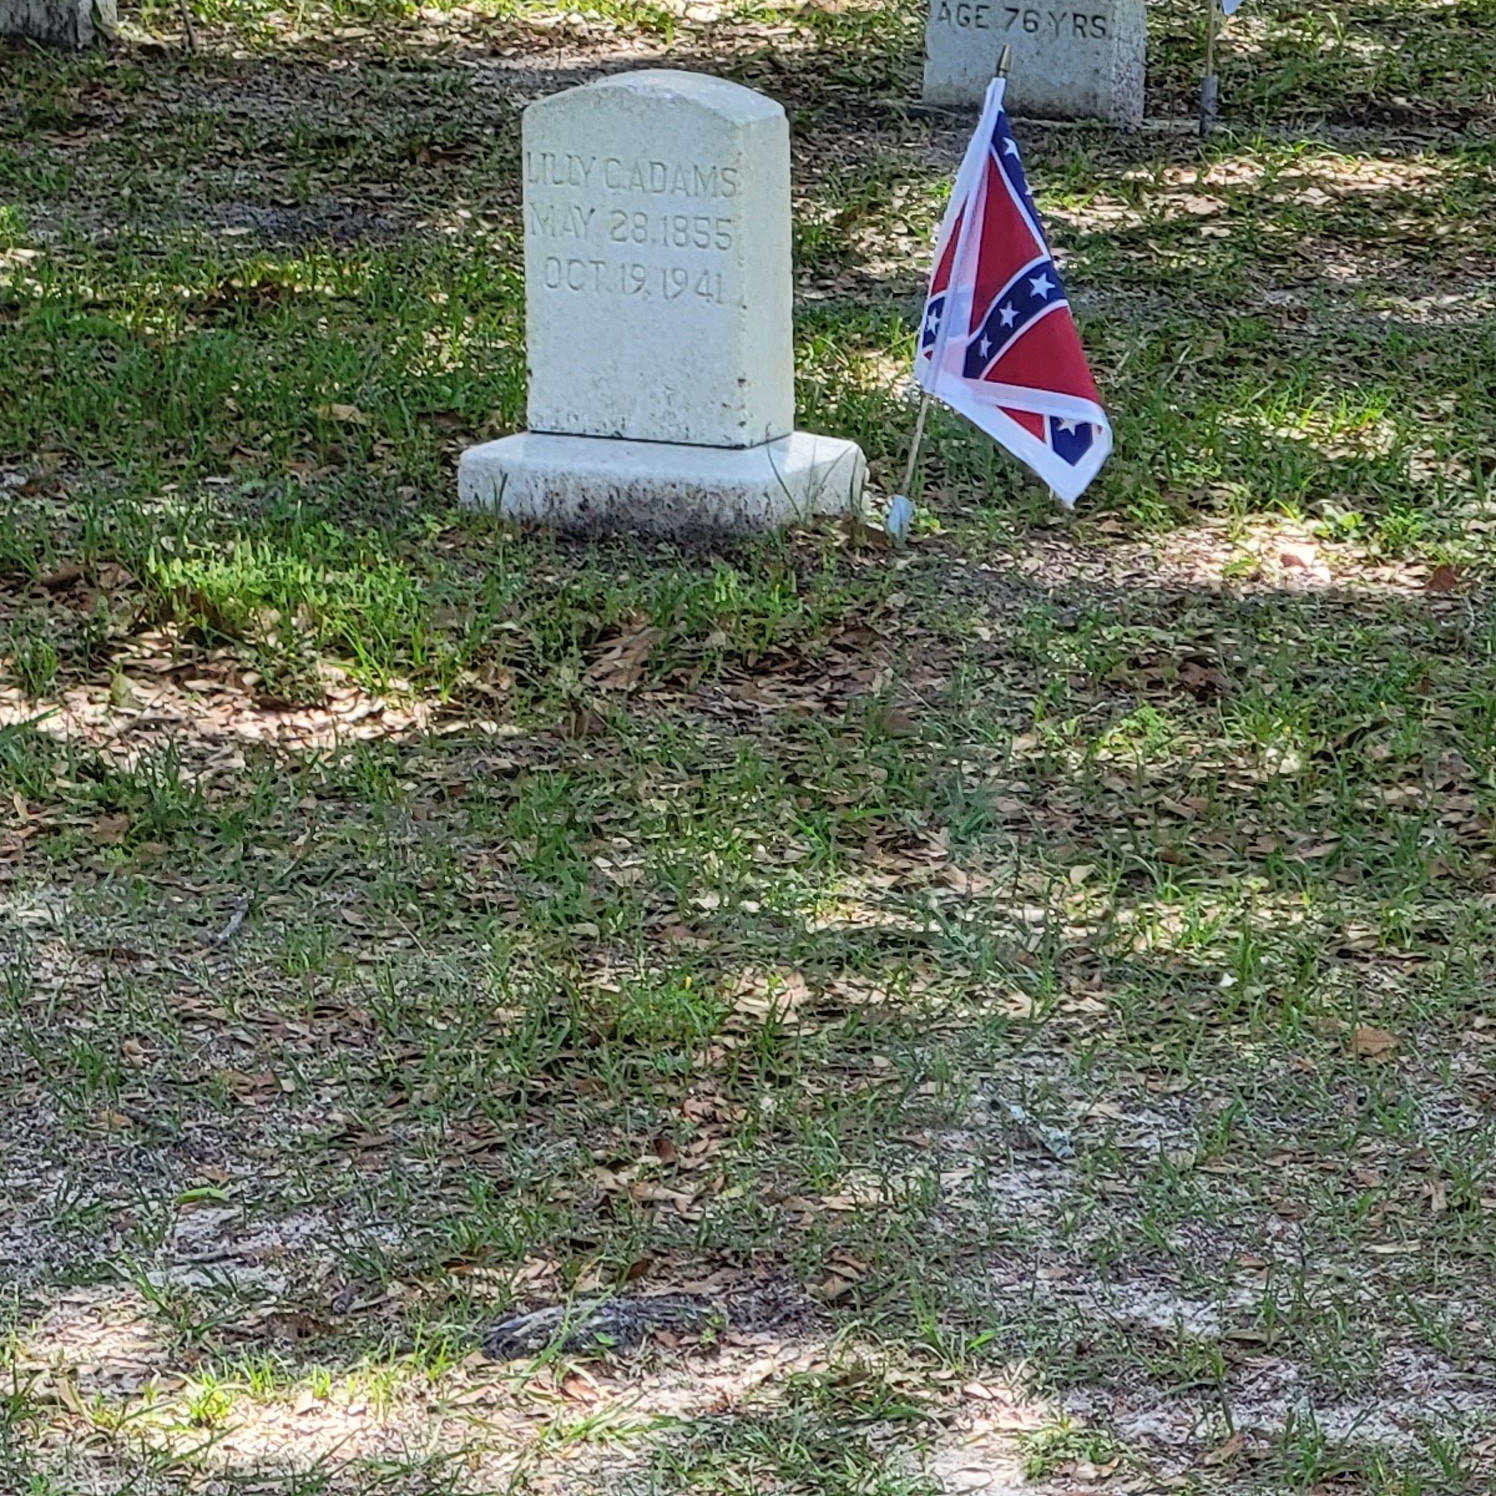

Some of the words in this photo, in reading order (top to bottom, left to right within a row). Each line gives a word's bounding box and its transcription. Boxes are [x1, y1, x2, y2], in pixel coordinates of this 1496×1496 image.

[936, 1, 991, 30] AGE
[1003, 6, 1042, 34] 76
[526, 151, 597, 189] LILLY
[527, 201, 597, 239] MAY
[662, 214, 733, 251] 1855
[660, 266, 725, 305] 1941
